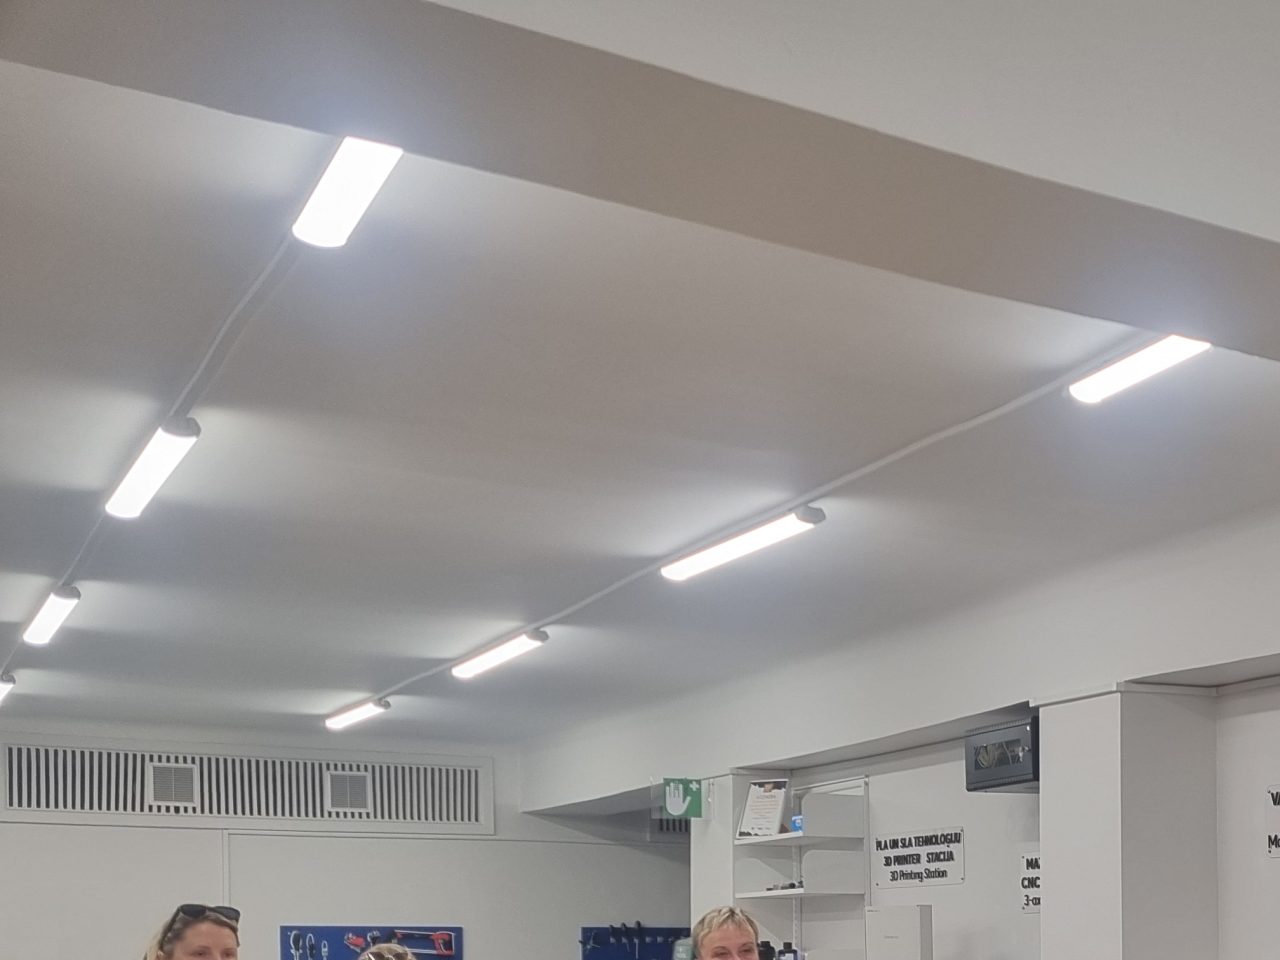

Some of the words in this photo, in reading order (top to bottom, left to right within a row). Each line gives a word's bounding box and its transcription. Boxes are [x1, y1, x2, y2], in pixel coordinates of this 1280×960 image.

[900, 837, 913, 849] SLA
[883, 856, 893, 867] 3D
[893, 853, 921, 866] PRINTER
[926, 850, 955, 863] STACIJA
[889, 870, 899, 881] 3D
[899, 869, 923, 883] Printing
[923, 867, 948, 879] Station
[1021, 876, 1040, 889] CNC
